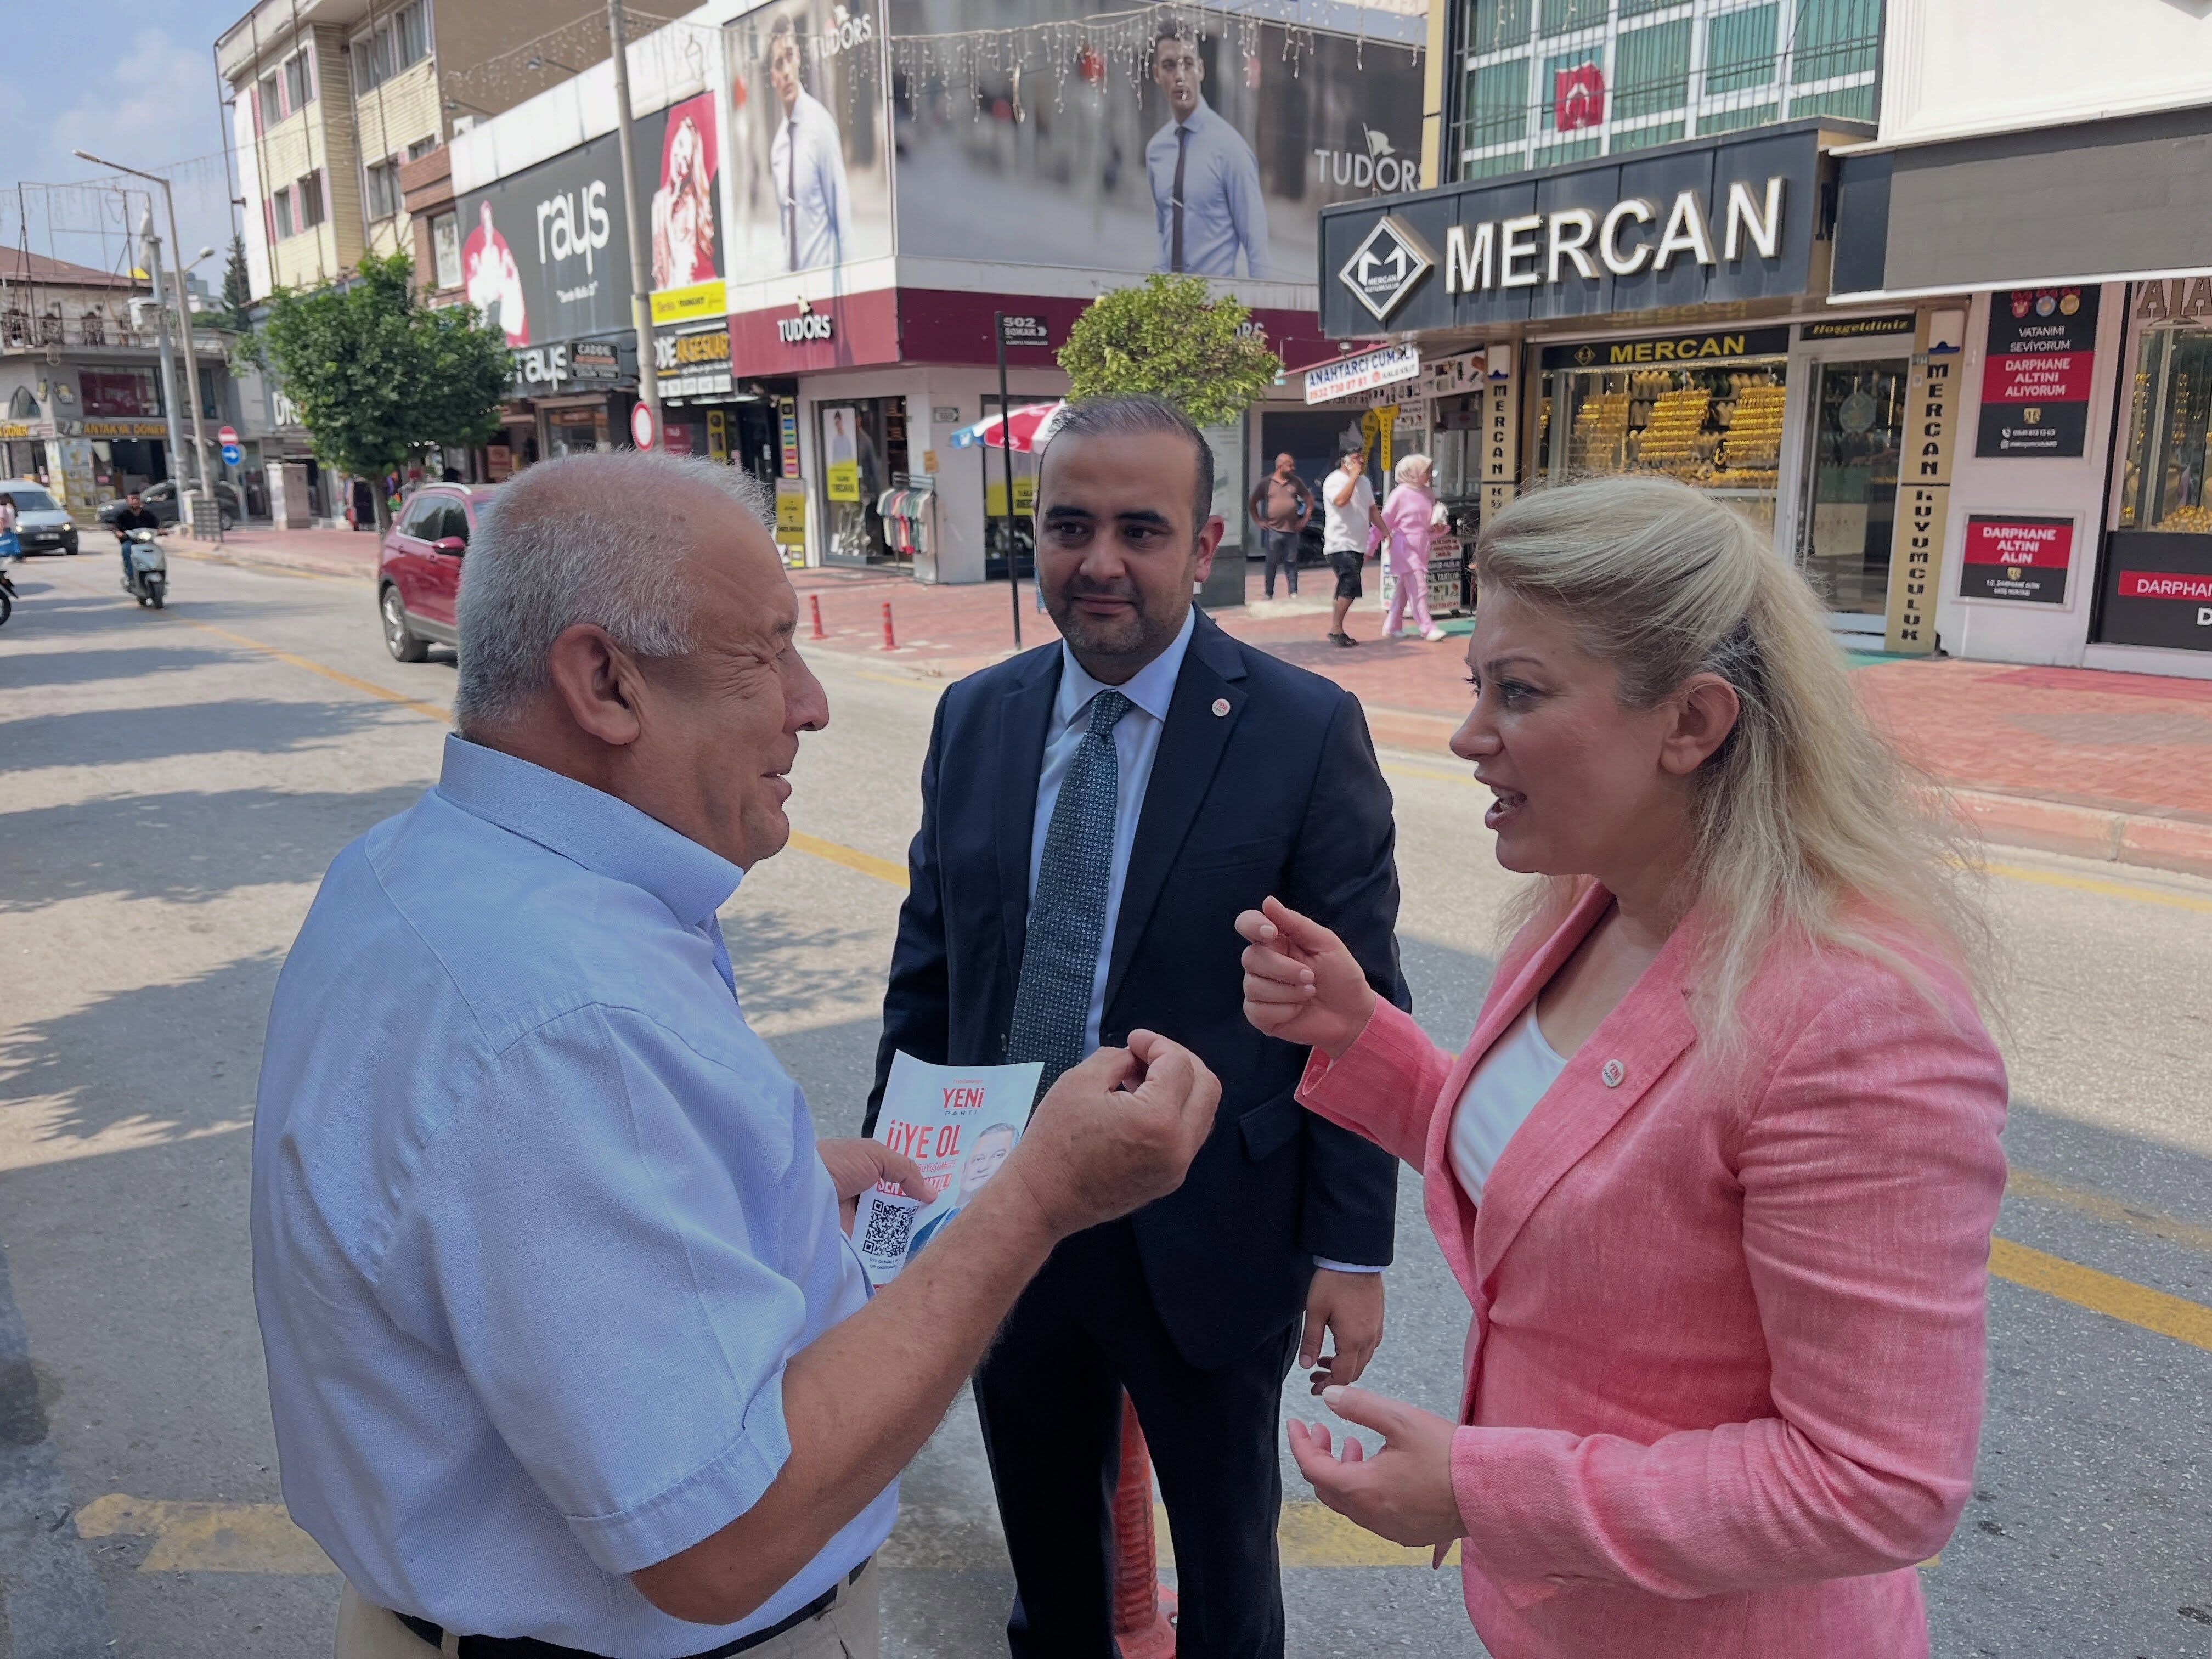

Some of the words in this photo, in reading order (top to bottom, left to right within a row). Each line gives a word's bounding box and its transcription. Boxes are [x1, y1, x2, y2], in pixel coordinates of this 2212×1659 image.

[1314, 148, 1422, 192] TUDOR
[1445, 176, 1785, 294] MERCAN
[777, 314, 831, 342] TUDORS
[1003, 317, 1036, 328] 502
[2019, 325, 2064, 337] VATANIMI
[1610, 334, 1746, 364] MERCAN
[1308, 357, 1369, 386] ANAHTARCI
[2005, 357, 2072, 371] DARPHANE
[2014, 372, 2059, 383] ALTINI
[2005, 384, 2067, 397] ALIYORUM
[1921, 363, 1949, 475] MERCAN
[1491, 385, 1508, 475] MERCAN
[1982, 526, 2057, 541] DARPHANE
[1996, 539, 2040, 553] ALTINI
[2000, 551, 2033, 564] ALIN
[886, 1119, 934, 1159] ÜYE
[936, 1124, 961, 1158] OL
